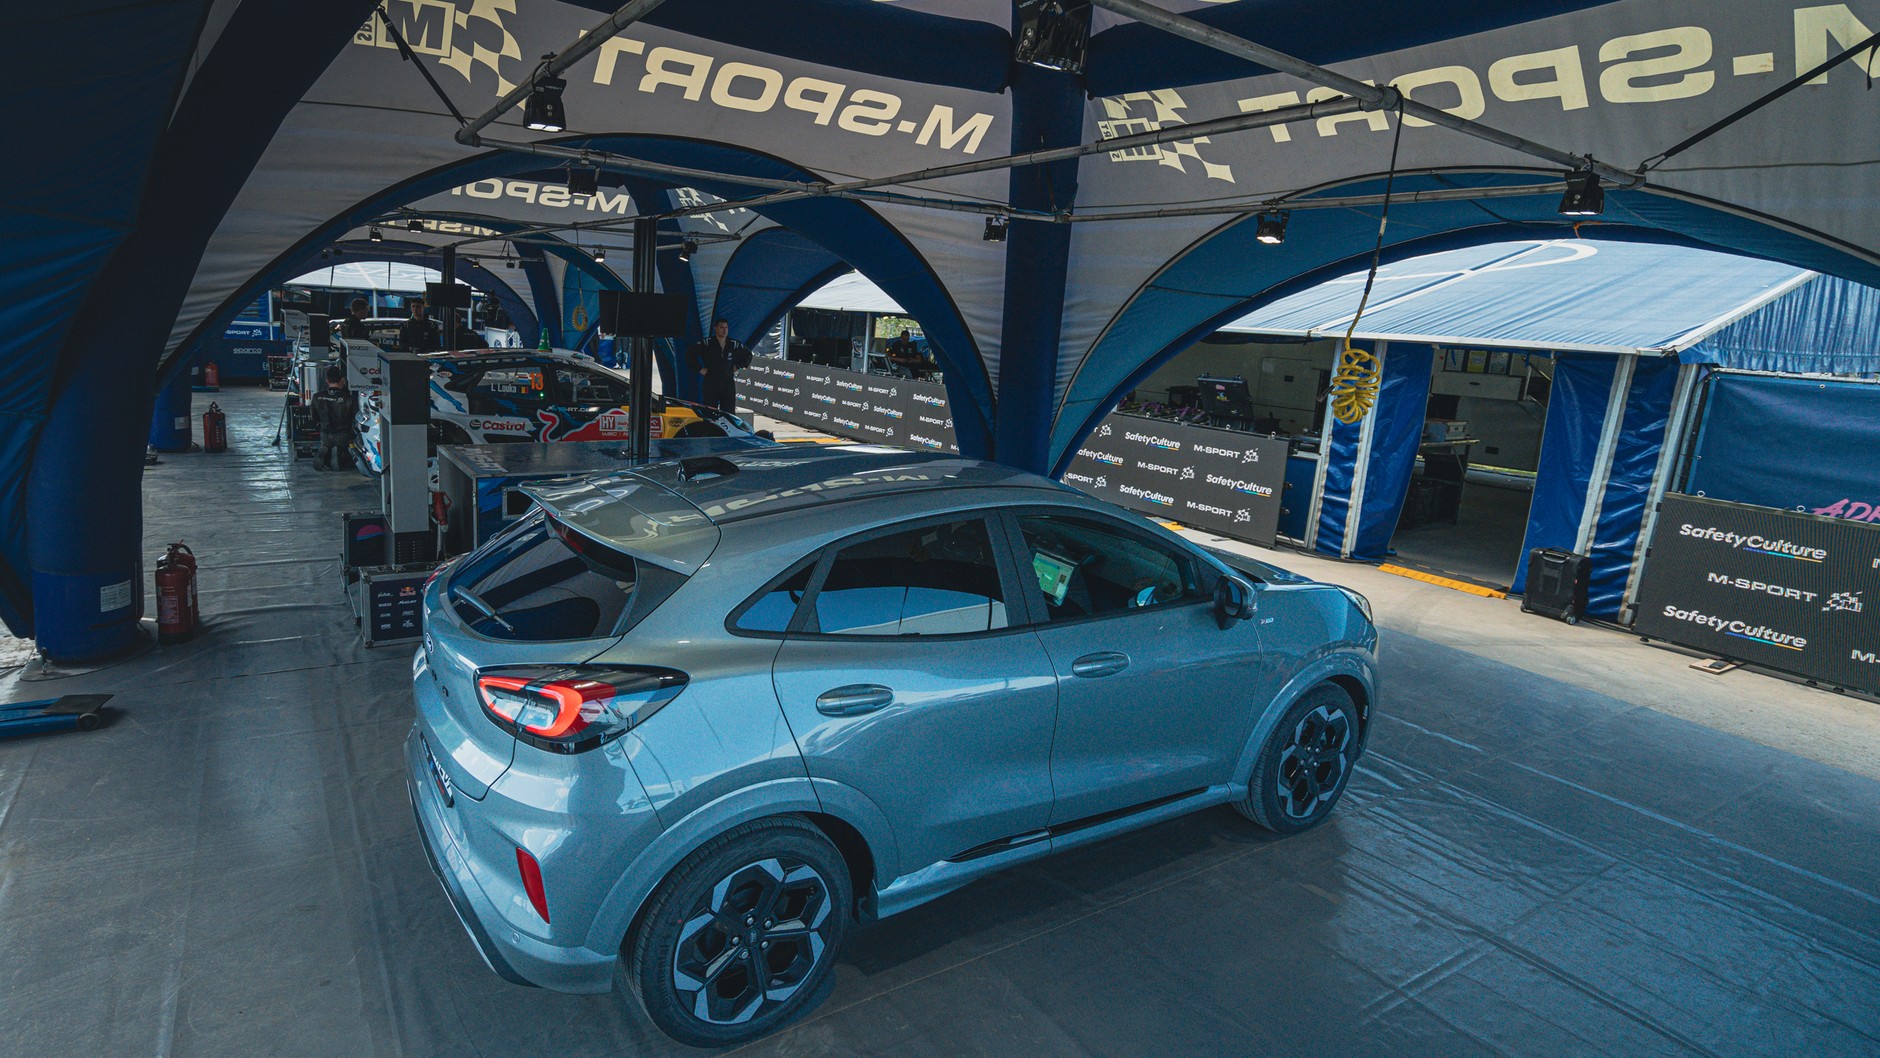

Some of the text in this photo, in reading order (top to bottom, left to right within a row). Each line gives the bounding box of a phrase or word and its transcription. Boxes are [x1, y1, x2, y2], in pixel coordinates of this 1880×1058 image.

[530, 372, 544, 391] 13
[868, 386, 889, 395] M-SPORT
[841, 400, 864, 410] M-SPORT
[912, 393, 946, 406] SafetyCulture
[873, 406, 903, 419] SafetyCulture
[482, 420, 526, 431] Castrol
[602, 416, 615, 430] HY
[919, 416, 944, 426] M-SPORT
[864, 424, 886, 434] M-SPORT
[909, 433, 943, 447] SafetyCulture
[1124, 431, 1181, 450] SafetyCulture
[1193, 444, 1241, 459] M-SPORT
[1137, 461, 1179, 476] M-SPORT
[1064, 472, 1094, 484] -SPORT
[1206, 474, 1273, 495] SafetyCulture
[1119, 484, 1174, 504] SafetyCulture
[1186, 500, 1233, 518] M-SPORT
[1679, 523, 1828, 560] SafetyCulture
[1707, 572, 1818, 602] M-SPORT
[1662, 605, 1807, 648] SafetyCulture
